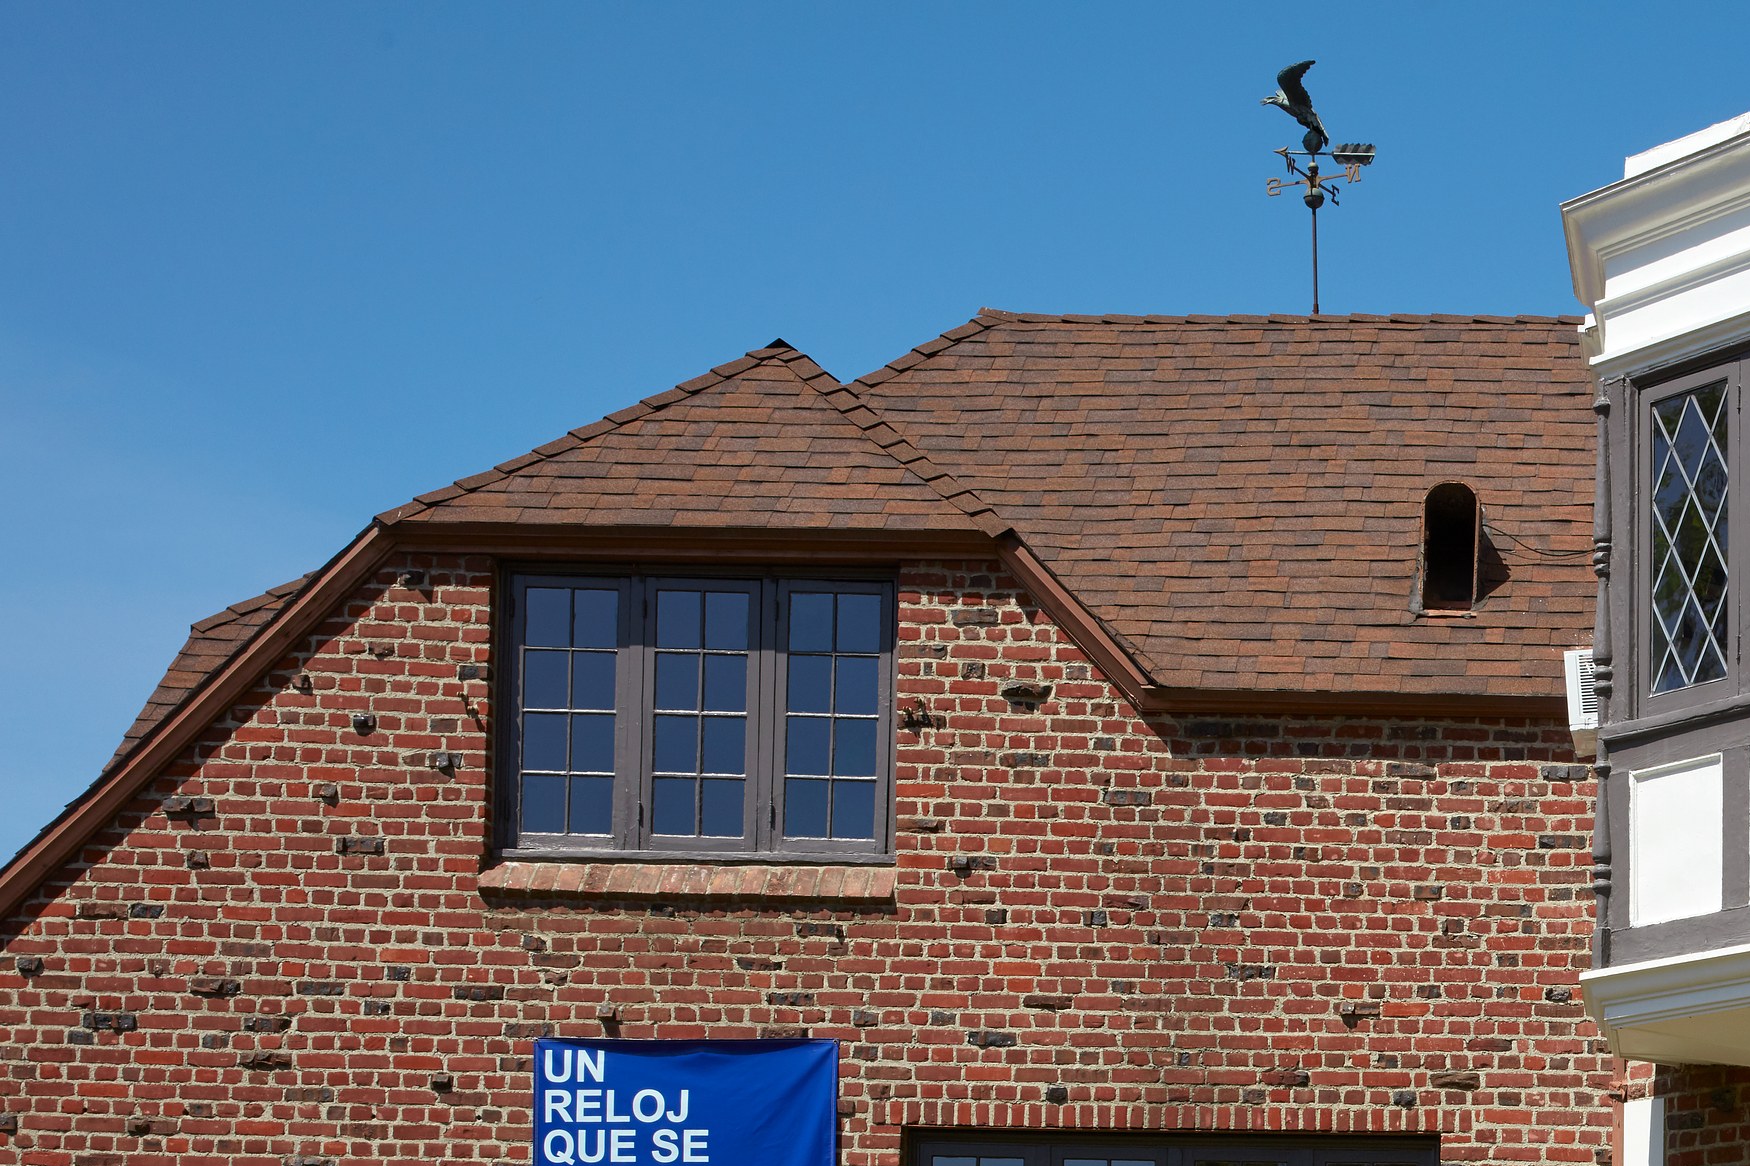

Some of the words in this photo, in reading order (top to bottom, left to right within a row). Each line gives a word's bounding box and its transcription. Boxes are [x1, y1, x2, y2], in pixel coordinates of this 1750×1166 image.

[1331, 184, 1340, 206] E
[543, 1049, 605, 1083] UN
[544, 1088, 689, 1123] RELOJ
[543, 1128, 637, 1165] QUE
[651, 1128, 710, 1163] SE
